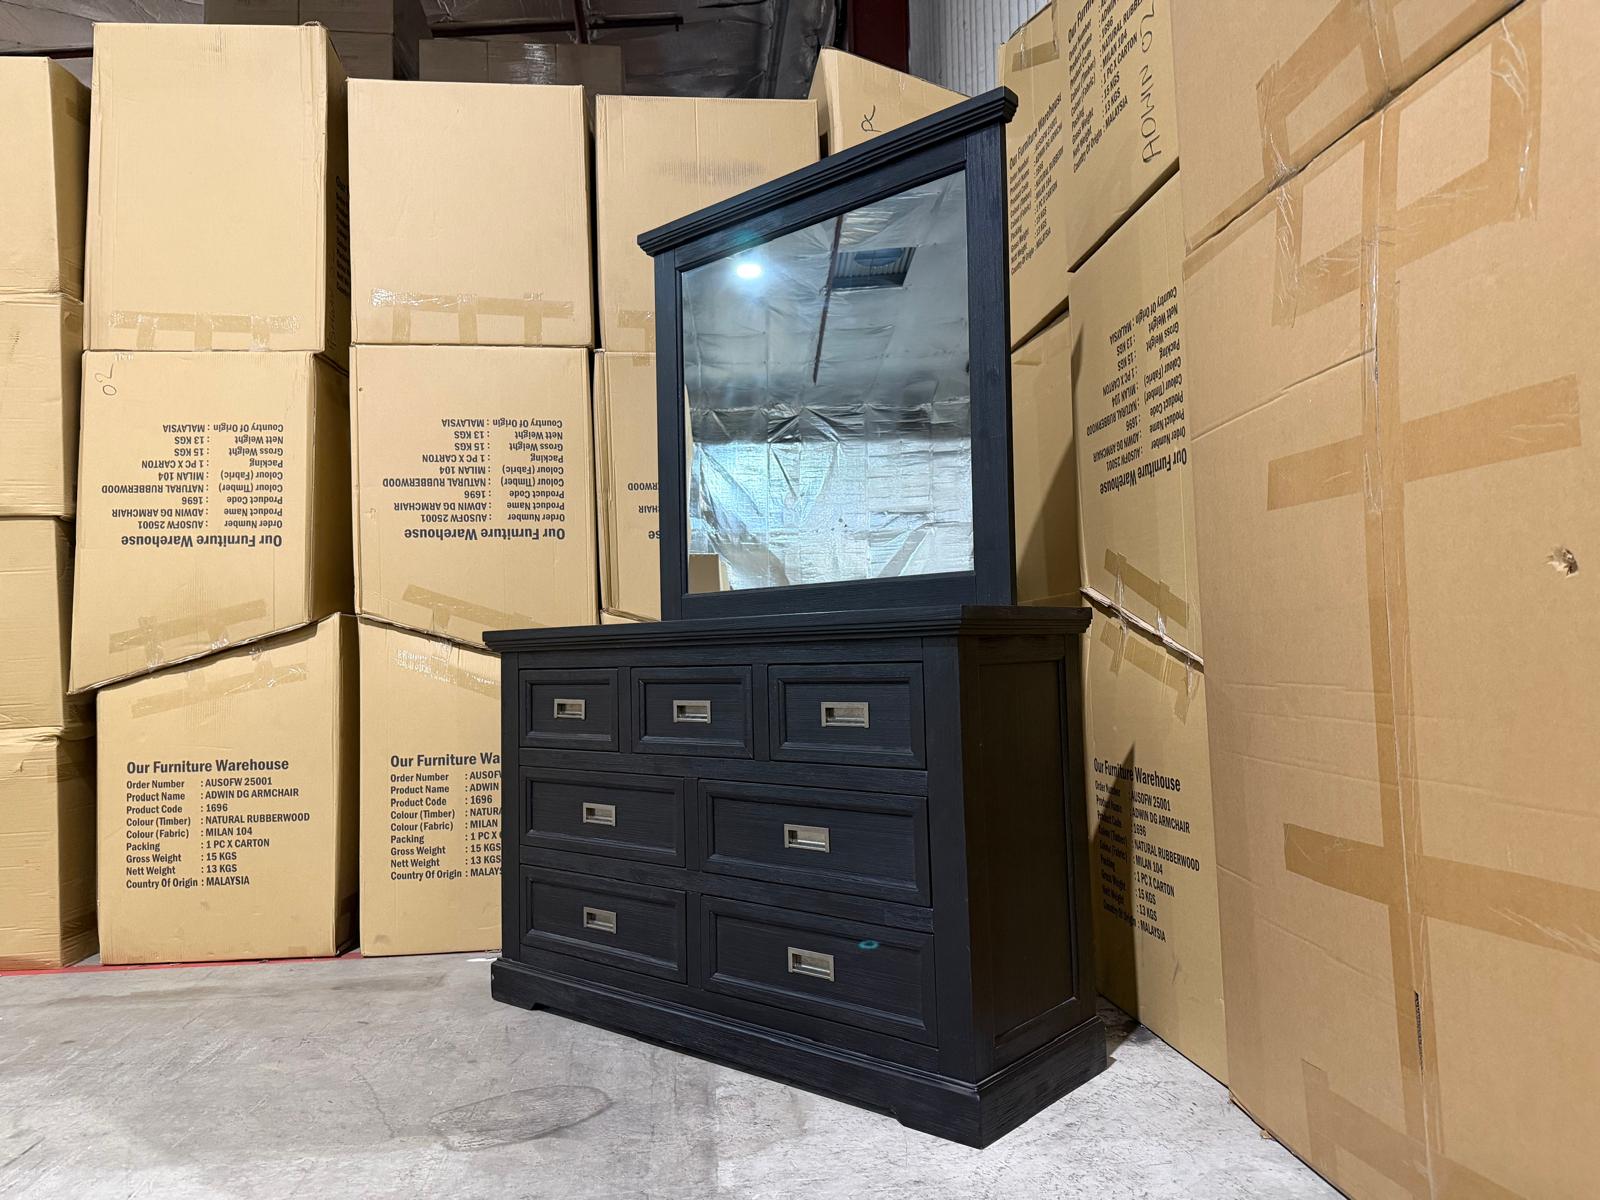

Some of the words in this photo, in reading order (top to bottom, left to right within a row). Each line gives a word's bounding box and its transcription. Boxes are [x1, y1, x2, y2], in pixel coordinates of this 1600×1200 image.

[442, 419, 484, 427] MALAYSIA
[493, 418, 517, 427] Origin
[531, 418, 562, 428] Country
[1164, 409, 1184, 426] Product
[214, 423, 238, 432] Origin
[251, 423, 283, 432] Country
[1149, 420, 1164, 433] Name
[235, 435, 263, 444] Weight
[1124, 432, 1139, 448] ADWIN
[1117, 440, 1123, 451] DG
[229, 447, 257, 456] Weight
[260, 448, 283, 456] Gross
[1093, 445, 1116, 463] ARMCHAIR
[1173, 448, 1187, 465] Our
[249, 458, 283, 468] Packing
[1138, 454, 1172, 479] Furniture
[158, 472, 174, 480] 104
[220, 470, 253, 480] (Fabric)
[256, 472, 283, 480] Colour
[383, 478, 445, 487] RUBBERWOOD
[448, 478, 486, 487] NATURAL
[501, 477, 535, 486] (Timber)
[538, 478, 564, 486] Colour
[1100, 469, 1137, 494] Warehouse
[219, 483, 253, 492] (Timber)
[112, 509, 158, 517] ARMCHAIR
[250, 508, 282, 516] Product
[224, 520, 257, 528] Number
[259, 520, 282, 528] Order
[404, 529, 477, 540] Warehouse
[481, 529, 539, 540] Furniture
[543, 528, 565, 540] Our
[121, 536, 193, 547] Warehouse
[197, 536, 256, 547] Furniture
[259, 535, 282, 546] Our
[391, 756, 413, 767] Our
[417, 754, 476, 766] Furniture
[127, 762, 150, 774] Our
[153, 760, 212, 773] Furniture
[216, 759, 289, 772] Warehouse
[391, 774, 413, 782] Order
[1094, 758, 1104, 773] Our
[1105, 760, 1134, 781] Furniture
[1134, 767, 1181, 792] Warehouse
[127, 780, 150, 789] Order
[152, 780, 184, 788] Number
[205, 778, 242, 787] AUSOFW
[245, 777, 272, 786] 25001
[127, 793, 159, 802] Product
[162, 792, 185, 800] Name
[206, 790, 234, 799] ADWIN
[237, 790, 249, 798] DG
[251, 788, 299, 797] ARMCHAIR
[391, 798, 422, 807] Product
[426, 797, 446, 806] Code
[471, 795, 492, 804] 1696
[1132, 791, 1152, 807] AUSOFW
[1153, 796, 1171, 811] 25001
[127, 805, 159, 814] Product
[162, 805, 182, 813] Code
[206, 804, 228, 812] 1696
[127, 818, 153, 826] Colour
[156, 816, 191, 827] (Timber)
[206, 815, 245, 824] NATURAL
[247, 813, 310, 822] RUBBERWOOD
[1132, 807, 1150, 821] ADWIN
[1150, 812, 1158, 824] DG
[1159, 814, 1190, 834] ARMCHAIR
[127, 830, 153, 839] Colour
[156, 829, 189, 839] (Fabric)
[206, 828, 233, 836] MILAN
[236, 827, 252, 835] 104
[1134, 824, 1147, 837] 1696
[127, 843, 160, 852] Packing
[214, 840, 225, 848] PC
[234, 839, 270, 847] CARTON
[391, 847, 414, 855] Gross
[417, 846, 446, 856] Weight
[484, 843, 501, 852] KGS
[127, 855, 150, 863] Gross
[152, 854, 181, 863] Weight
[207, 853, 217, 861] 15
[220, 852, 237, 860] KGS
[1134, 839, 1157, 857] NATURAL
[1158, 847, 1200, 871] RUBBERWOOD
[126, 867, 144, 875] Nett
[147, 866, 176, 876] Weight
[220, 864, 237, 873] KGS
[1135, 855, 1152, 870] MILAN
[1153, 862, 1163, 875] 104
[126, 879, 159, 889] Country
[162, 878, 171, 887] Of
[173, 878, 198, 887] Origin
[207, 876, 249, 886] MALAYSIA
[1141, 873, 1148, 885] PC
[1153, 878, 1175, 897] CARTON
[1138, 888, 1145, 900] 15
[1145, 891, 1156, 905] KGS
[1139, 904, 1145, 916] 13
[1147, 908, 1157, 921] KGS
[1140, 920, 1166, 942] MALAYSIA
